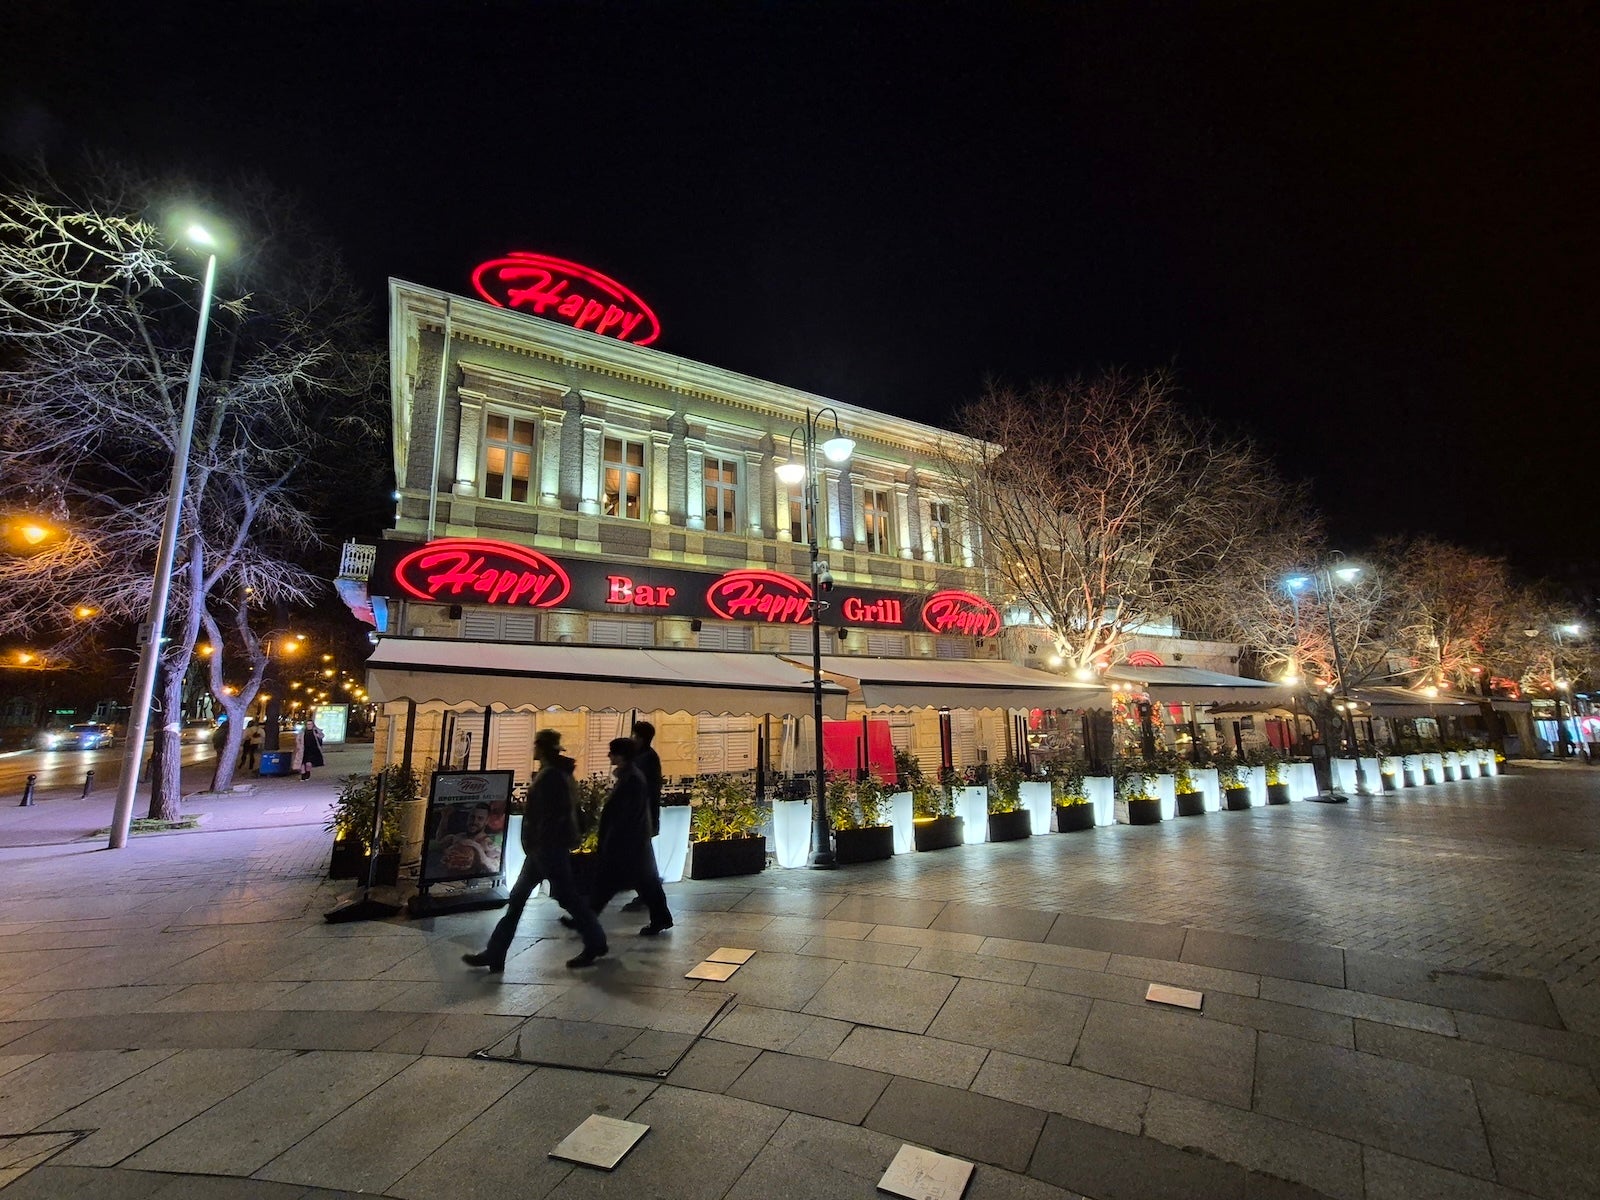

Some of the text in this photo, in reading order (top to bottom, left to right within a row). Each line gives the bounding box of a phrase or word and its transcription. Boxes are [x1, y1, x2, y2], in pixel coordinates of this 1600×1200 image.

[499, 267, 645, 340] Happy
[420, 551, 556, 605] Happy
[605, 575, 677, 607] Bar
[722, 580, 811, 623] Happy
[843, 597, 903, 623] Grill
[932, 600, 993, 635] Happy
